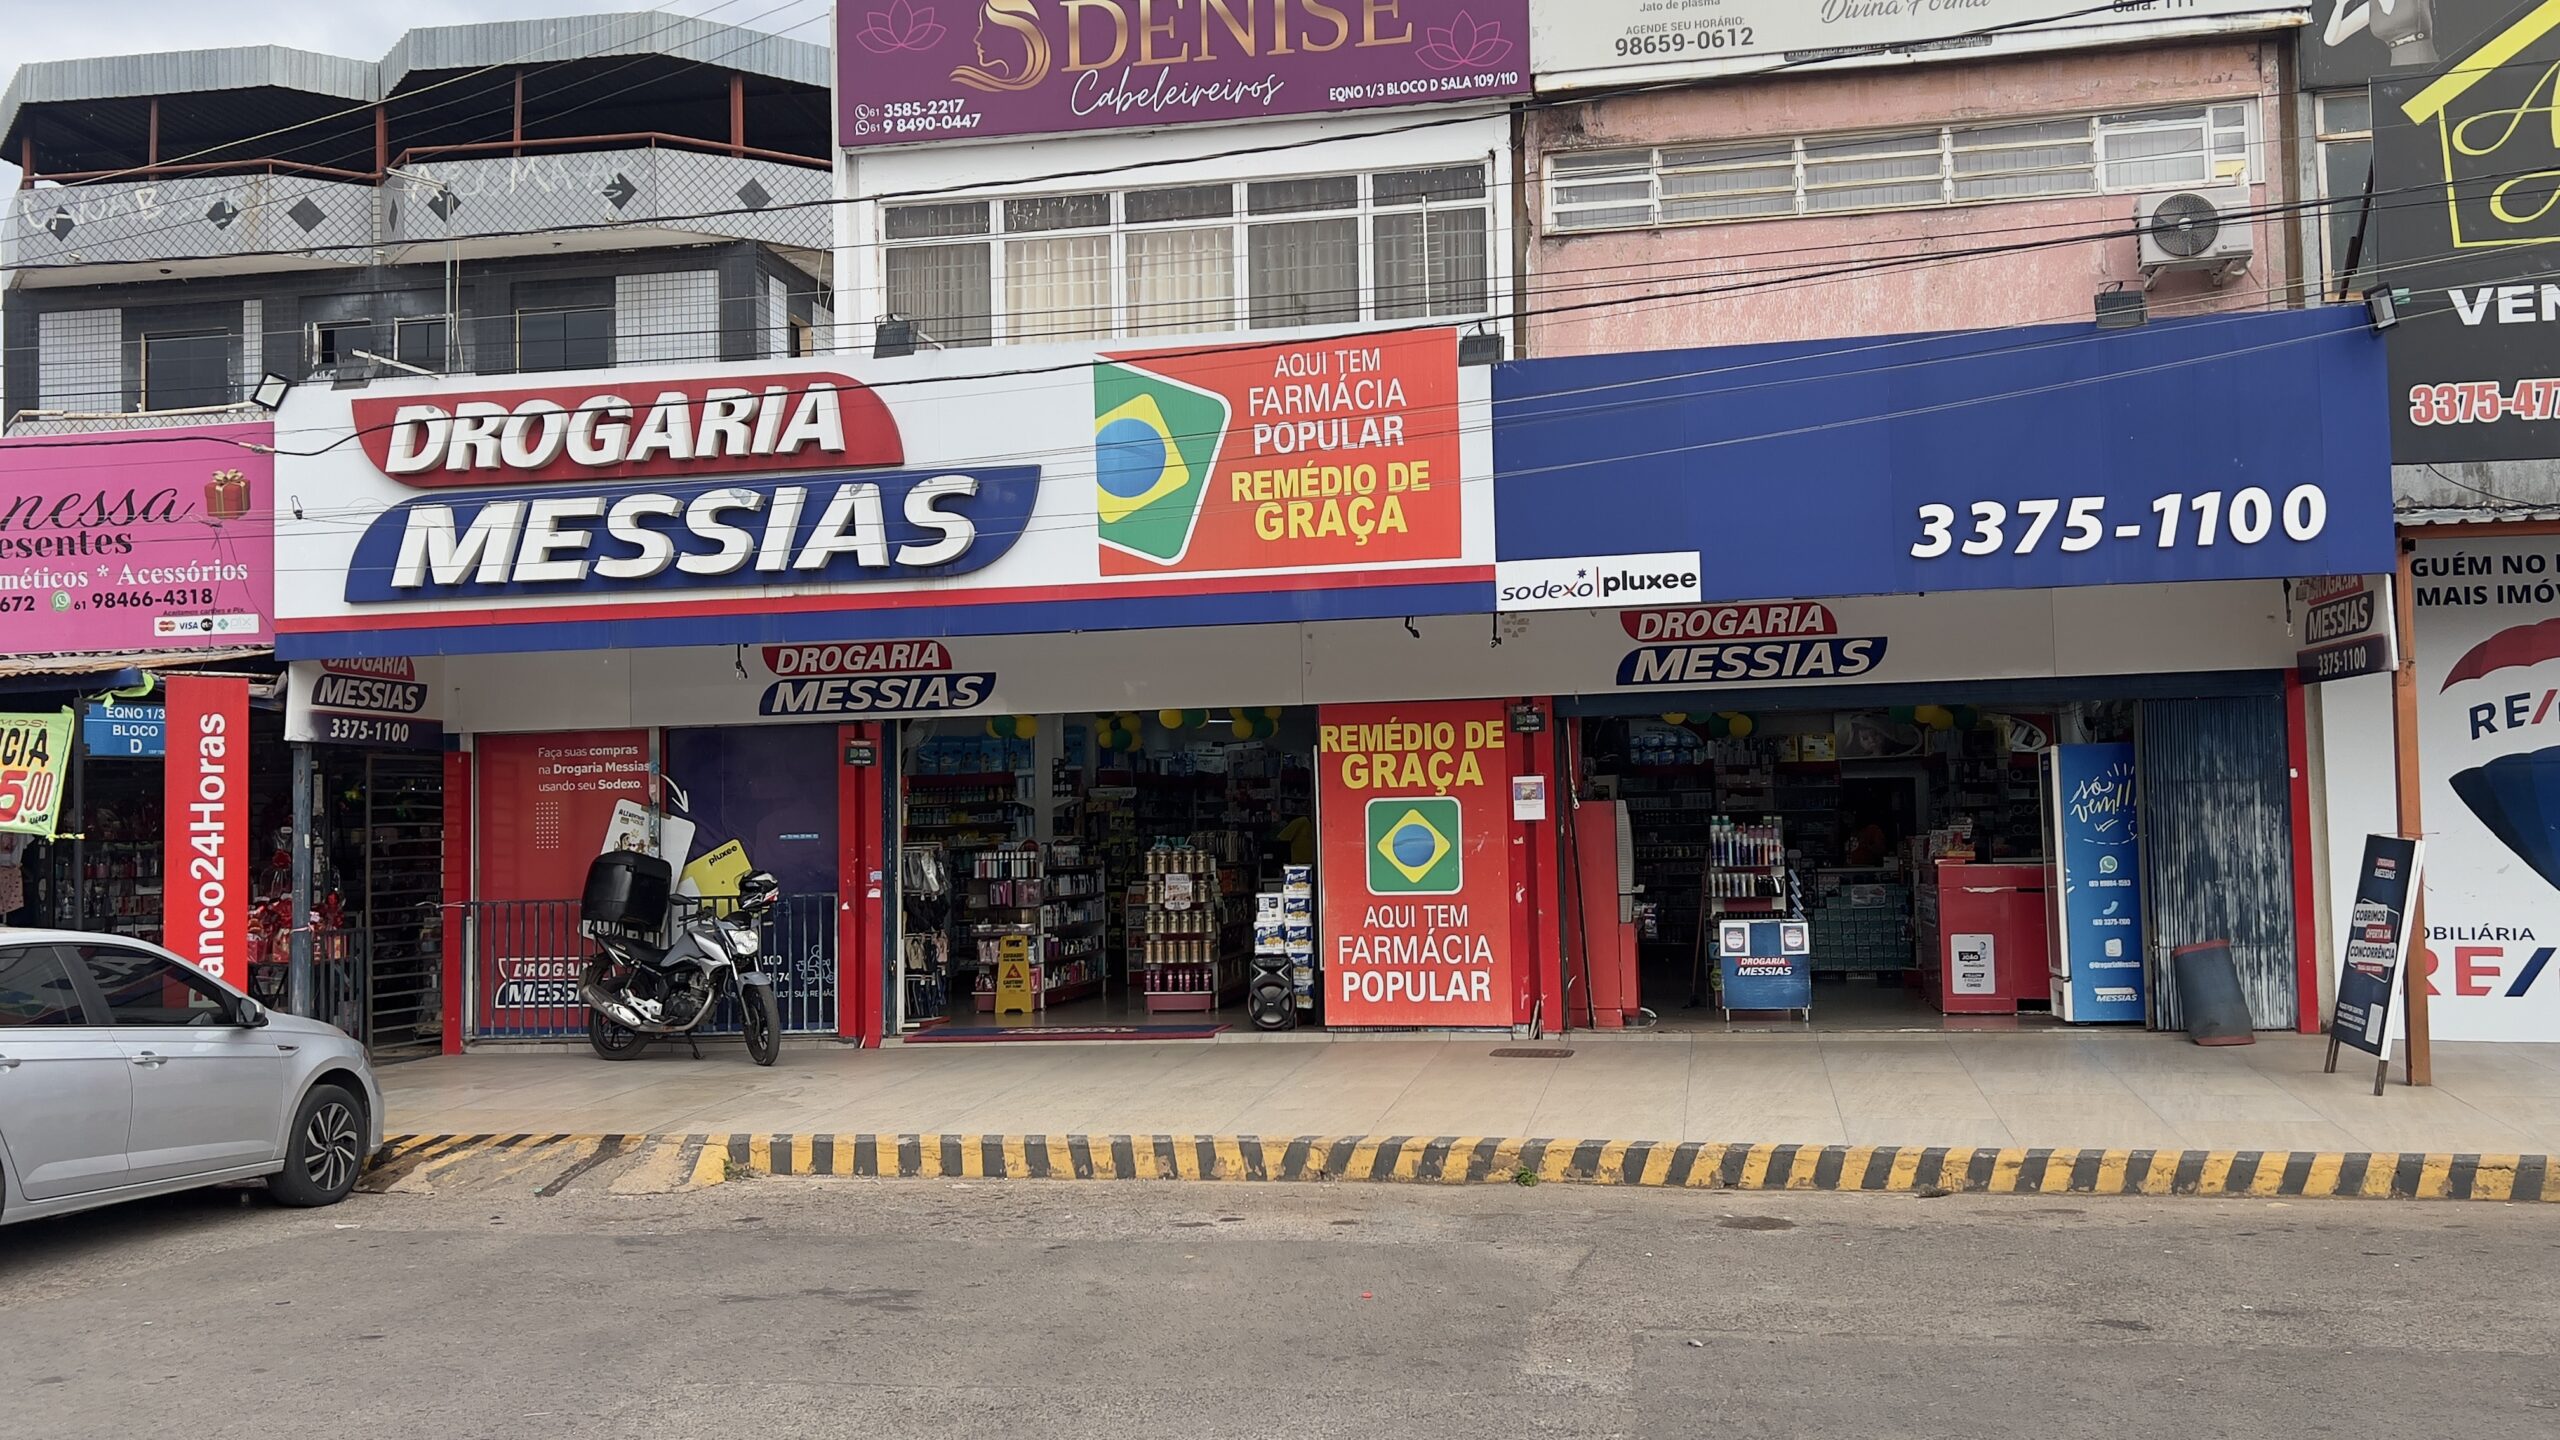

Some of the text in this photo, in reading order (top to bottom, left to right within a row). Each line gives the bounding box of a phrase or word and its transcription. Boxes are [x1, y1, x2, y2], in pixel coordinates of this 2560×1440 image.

[1640, 1, 1663, 12] Jato
[1666, 0, 1679, 10] de
[1821, 0, 1900, 24] Divina
[1061, 0, 1413, 72] DENISE
[1626, 15, 1745, 35] AGENDE SEU HORÁRIO:
[1615, 26, 1754, 57] 98659-0612
[1071, 66, 1285, 116] Cabeleireiros
[1329, 71, 1518, 102] EQNO 1/3 BLOCO D SALA 109/110
[869, 99, 965, 118] 61 3585-2217
[870, 113, 982, 134] 61 9 8490-0447
[1274, 347, 1381, 379] AQUI TEM
[1248, 374, 1407, 417] FARMÁCIA
[386, 383, 846, 473] DROGARIA
[1253, 415, 1405, 455] POPULAR
[1231, 460, 1431, 502] REMÉDIO DE
[391, 475, 979, 587] MESSIAS
[1254, 495, 1409, 546] GRAÇA
[1910, 483, 2328, 558] 3375-1100
[0, 559, 248, 590] méticos Acessórios
[2410, 552, 2546, 576] GUÉM NO
[74, 601, 86, 610] 61
[92, 588, 213, 609] 98466-4318
[1501, 570, 1697, 601] sodexo pluxee
[2416, 586, 2487, 606] MAIS
[180, 622, 198, 630] VISA
[1637, 605, 1825, 640] DROGARIA
[2309, 597, 2369, 641] MESSIAS
[776, 643, 940, 674] DROGARIA
[1632, 639, 1873, 683] MESSIAS
[2319, 645, 2367, 676] 3375-1100
[319, 677, 419, 711] MESSIAS
[771, 676, 983, 713] MESSIAS
[106, 706, 166, 719] EQNO 1/3
[2469, 689, 2560, 741] RE/
[112, 724, 159, 737] BLOCO
[330, 718, 409, 742] 3375-1100
[1321, 717, 1505, 753] REMÉDIO DE
[0, 728, 49, 767] CIA
[130, 738, 143, 754] D
[538, 746, 638, 759] Faça suas compras
[539, 761, 649, 776] na Drogaria Messias
[1342, 751, 1485, 797] GRAÇA
[539, 779, 643, 792] usando seu Sodexo.
[708, 845, 738, 866] pluxee
[1363, 905, 1468, 929] AQUI TEM
[2355, 910, 2386, 922] COBRIMOS
[1338, 927, 1494, 965] FARMÁCIA
[1740, 957, 1786, 966] DROGARIA
[2350, 945, 2395, 959] CONCORRÊNCIA
[1342, 970, 1491, 1002] POPULAR
[1738, 966, 1792, 976] MESSIAS
[2096, 994, 2137, 1002] MESSIAS
